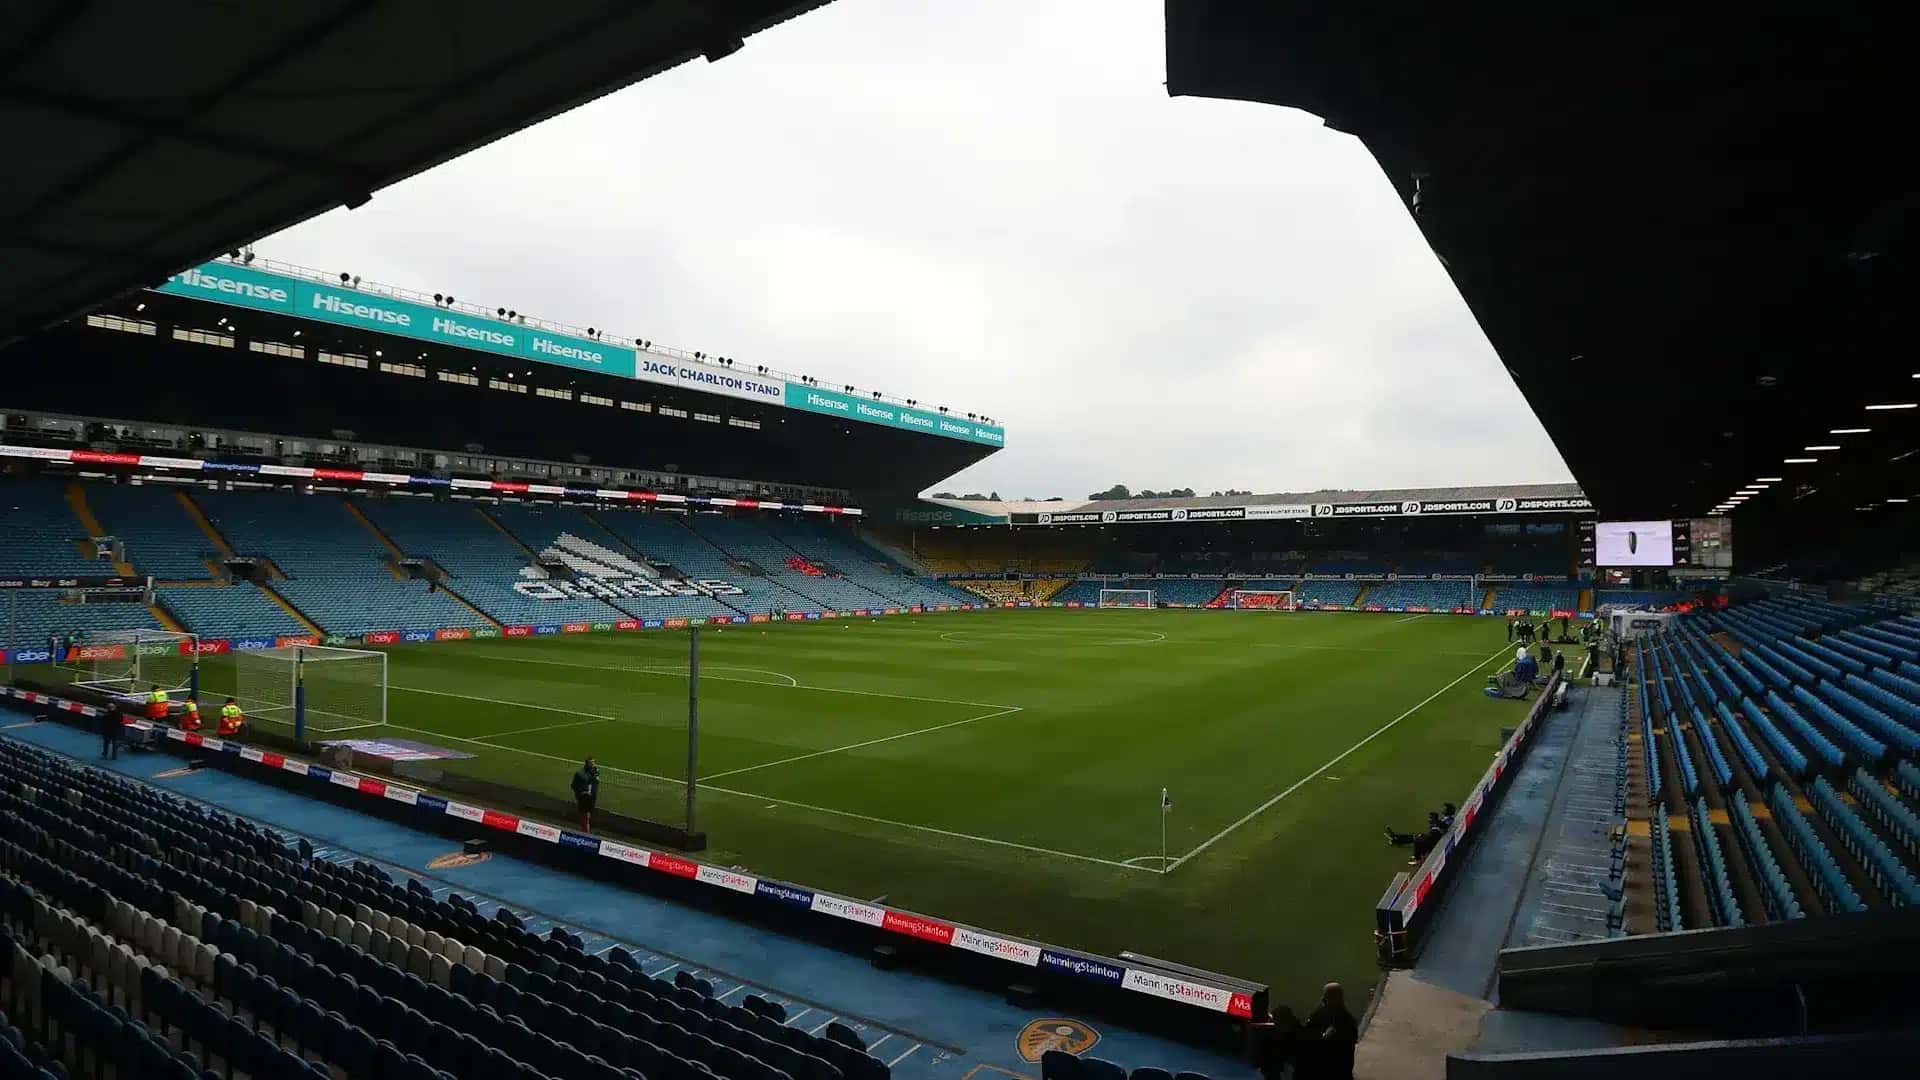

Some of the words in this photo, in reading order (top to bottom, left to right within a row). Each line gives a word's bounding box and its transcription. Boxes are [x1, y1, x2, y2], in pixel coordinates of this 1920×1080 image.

[312, 292, 411, 327] Hisense
[432, 317, 514, 347] Hisense
[532, 337, 604, 364] Hisense
[643, 361, 678, 377] JACK
[680, 368, 743, 390] CHARLTON
[745, 382, 780, 397] STAND
[807, 393, 849, 411] Hisense
[856, 403, 894, 420] Hisense
[900, 412, 934, 428] Hisense
[939, 420, 971, 436] Hisense
[975, 427, 1002, 443] Hisense
[1318, 505, 1331, 515] JD
[1335, 505, 1398, 514] JDSPORTS.COM
[1405, 503, 1418, 512] JD
[1423, 502, 1490, 512] JDSPORTS.COM
[1499, 500, 1514, 510] JD
[537, 624, 557, 635] ebay
[566, 623, 585, 633] ebay
[619, 619, 638, 630] ebay
[405, 631, 430, 643] ebay
[440, 630, 465, 641] ebay
[475, 628, 497, 639] ebay
[507, 626, 529, 637] ebay
[238, 638, 269, 651] ebay
[16, 649, 51, 662] eba
[650, 855, 696, 874] ManningStainton
[702, 869, 750, 888] ManningStainton
[757, 883, 812, 903] ManningStainton
[819, 898, 876, 920] ManningStainton
[886, 915, 949, 938] ManningStainton
[960, 932, 1030, 958] ManningStainton
[1042, 953, 1120, 980] ManningStainton
[1133, 974, 1217, 1003] ManningStainton
